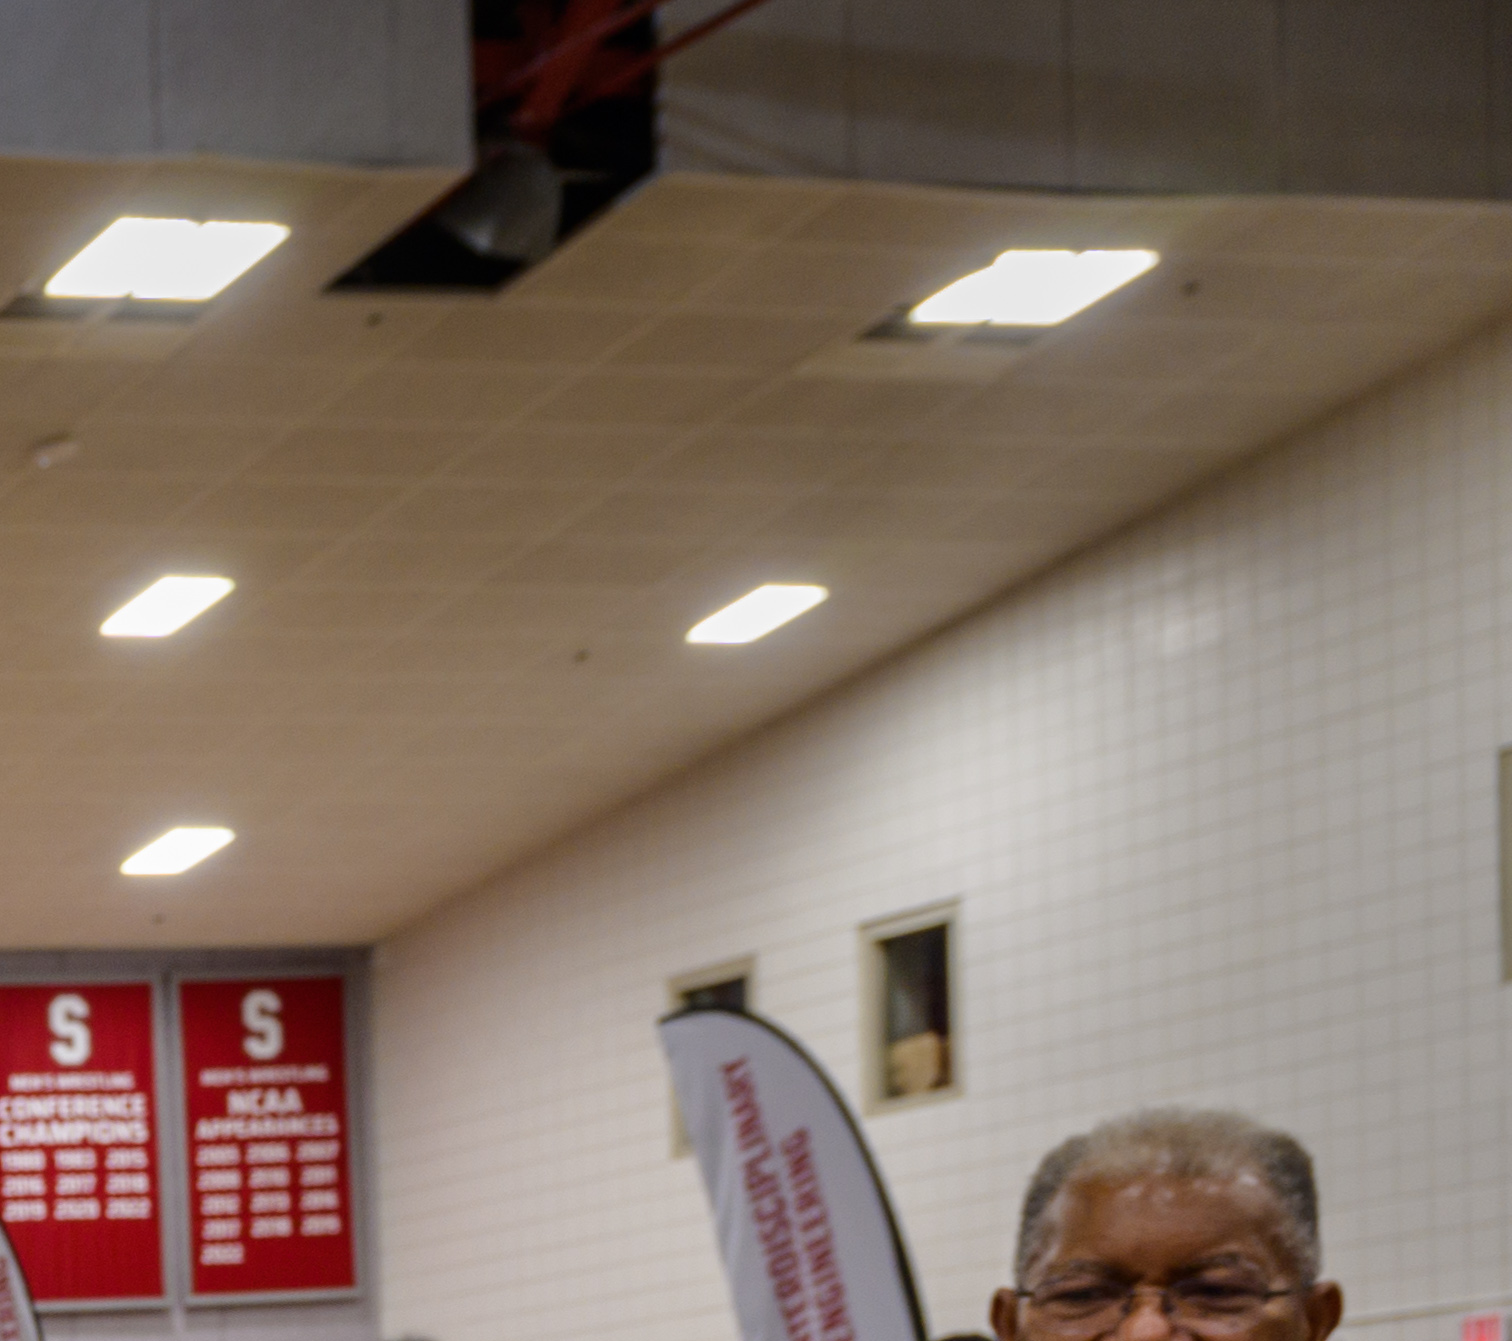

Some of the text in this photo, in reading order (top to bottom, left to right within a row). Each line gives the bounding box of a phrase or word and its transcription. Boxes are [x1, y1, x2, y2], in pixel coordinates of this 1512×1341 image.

[47, 994, 93, 1067] S
[241, 990, 284, 1060] S
[226, 1086, 304, 1115] NCAA
[195, 1113, 339, 1141] APPEARANCES
